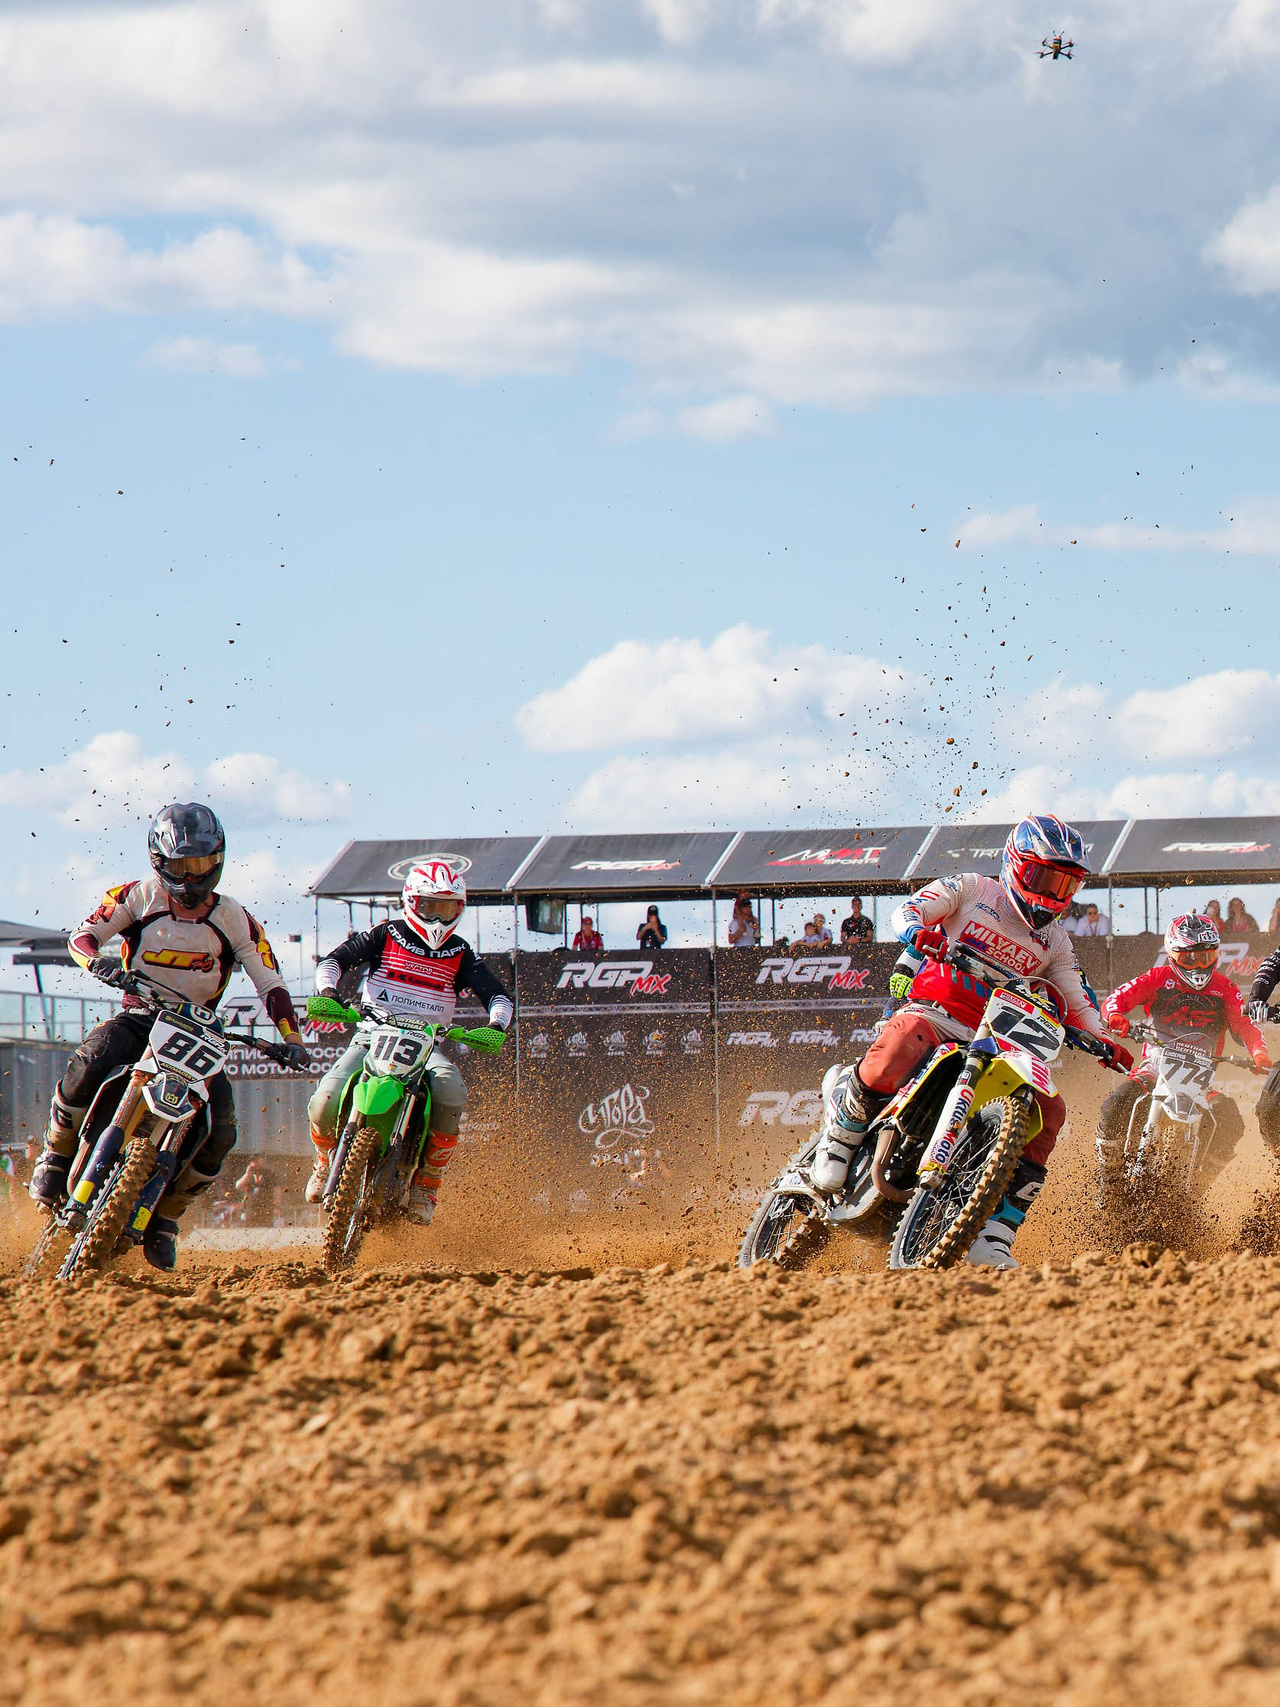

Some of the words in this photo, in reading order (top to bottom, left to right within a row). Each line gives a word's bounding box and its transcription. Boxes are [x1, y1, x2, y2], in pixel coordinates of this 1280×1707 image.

[387, 924, 425, 955] ДРАЙВ
[429, 943, 466, 958] ПАРК
[965, 924, 1038, 970] MILYAEV
[755, 956, 852, 985] RGP
[828, 969, 871, 990] MX
[986, 947, 1026, 974] SCHOOL
[556, 961, 653, 989] RGP
[630, 973, 672, 995] MX
[391, 995, 445, 1013] ПОЛИМЕТАЛЛ
[374, 1035, 423, 1066] 113
[990, 1005, 1060, 1062] 12
[158, 1031, 222, 1076] 86
[1163, 1058, 1213, 1090] 774
